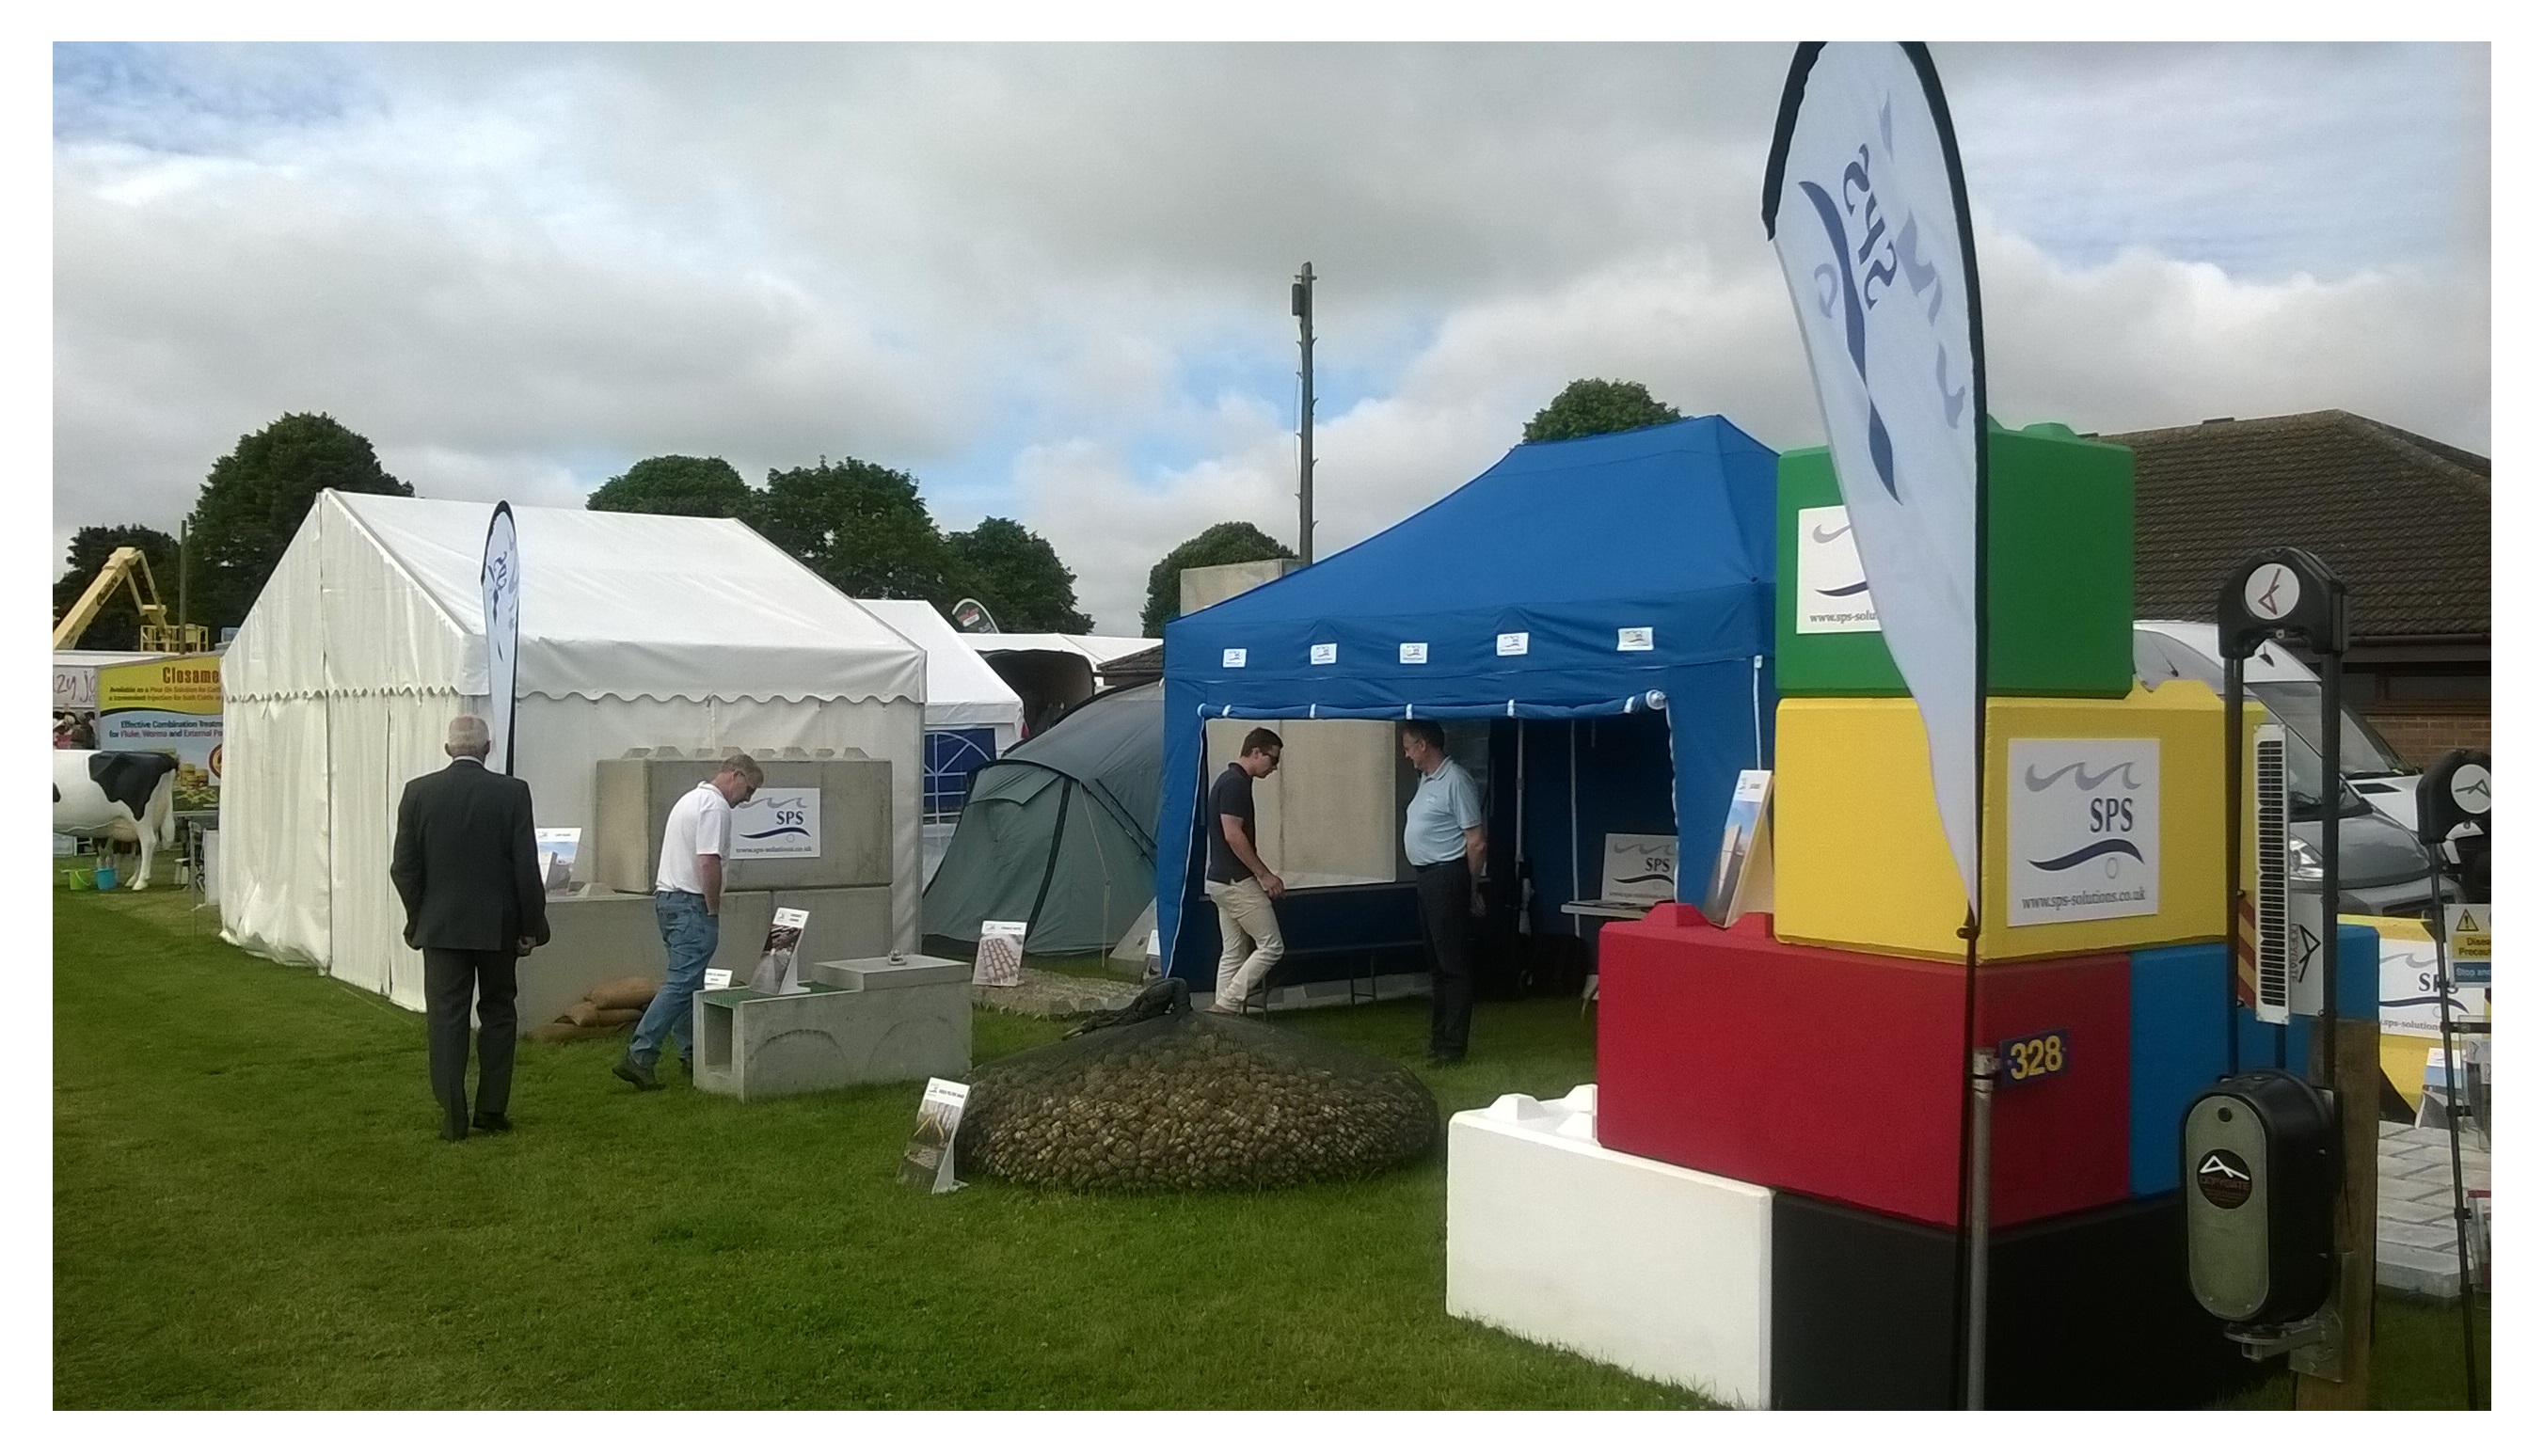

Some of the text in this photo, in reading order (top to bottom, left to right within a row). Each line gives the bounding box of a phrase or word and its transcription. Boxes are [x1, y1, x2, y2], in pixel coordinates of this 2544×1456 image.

[1809, 609, 1878, 625] www.sps-solu
[162, 666, 220, 685] Closame
[775, 810, 804, 826] SPS
[2089, 797, 2134, 834] SPS
[1645, 857, 1671, 874] SPS
[2021, 885, 2147, 911] www.sps-solutions.co.uk
[2380, 1019, 2441, 1031] .sps-solution
[2010, 1035, 2063, 1081] 328
